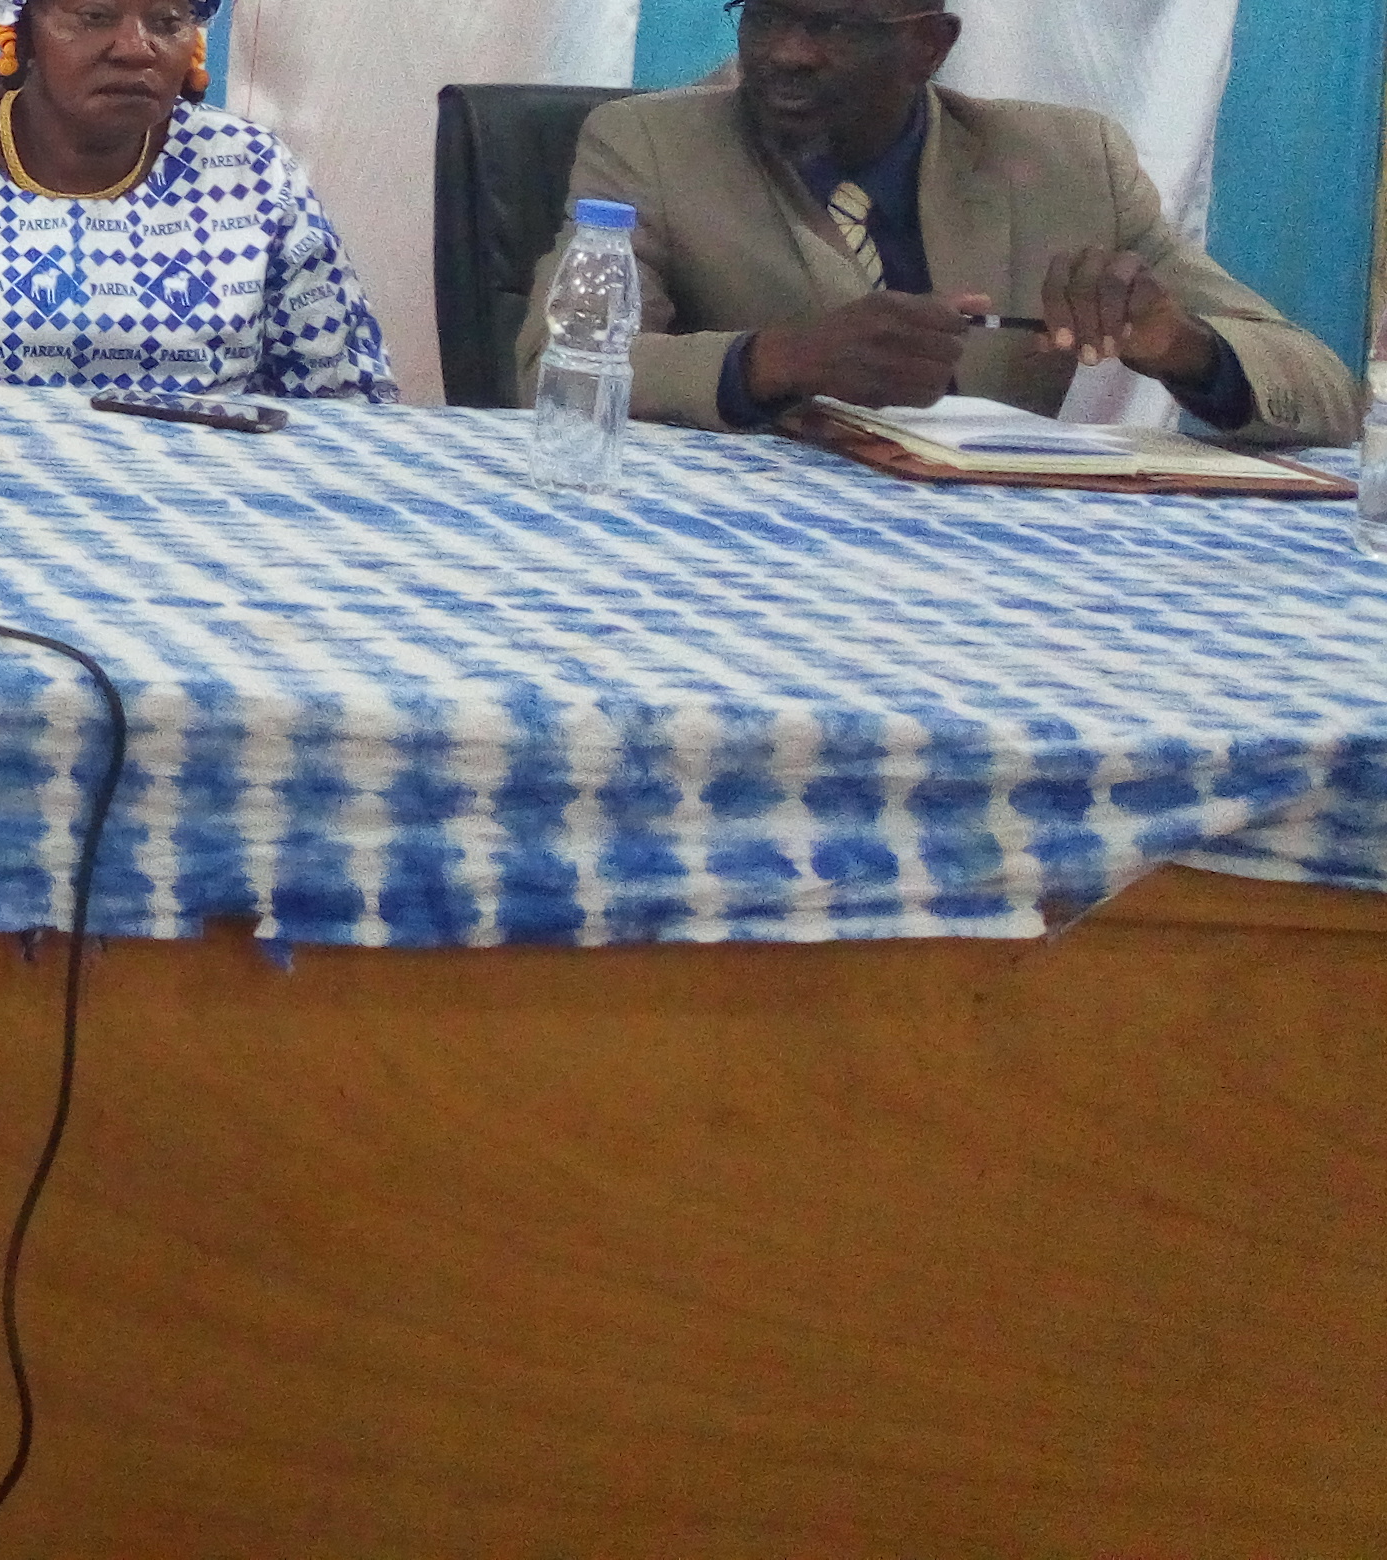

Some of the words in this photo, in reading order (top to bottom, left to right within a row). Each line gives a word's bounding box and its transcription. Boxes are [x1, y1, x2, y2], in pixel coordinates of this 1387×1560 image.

[201, 154, 251, 168] PARENA
[19, 218, 68, 231] PARENA
[86, 217, 129, 232] PARENA
[142, 221, 192, 236] PARENA
[211, 215, 260, 231] PARENA
[91, 283, 138, 296] PARENA
[23, 345, 72, 359] PARENA
[92, 348, 142, 361] PARENA
[159, 348, 209, 362] PARENA
